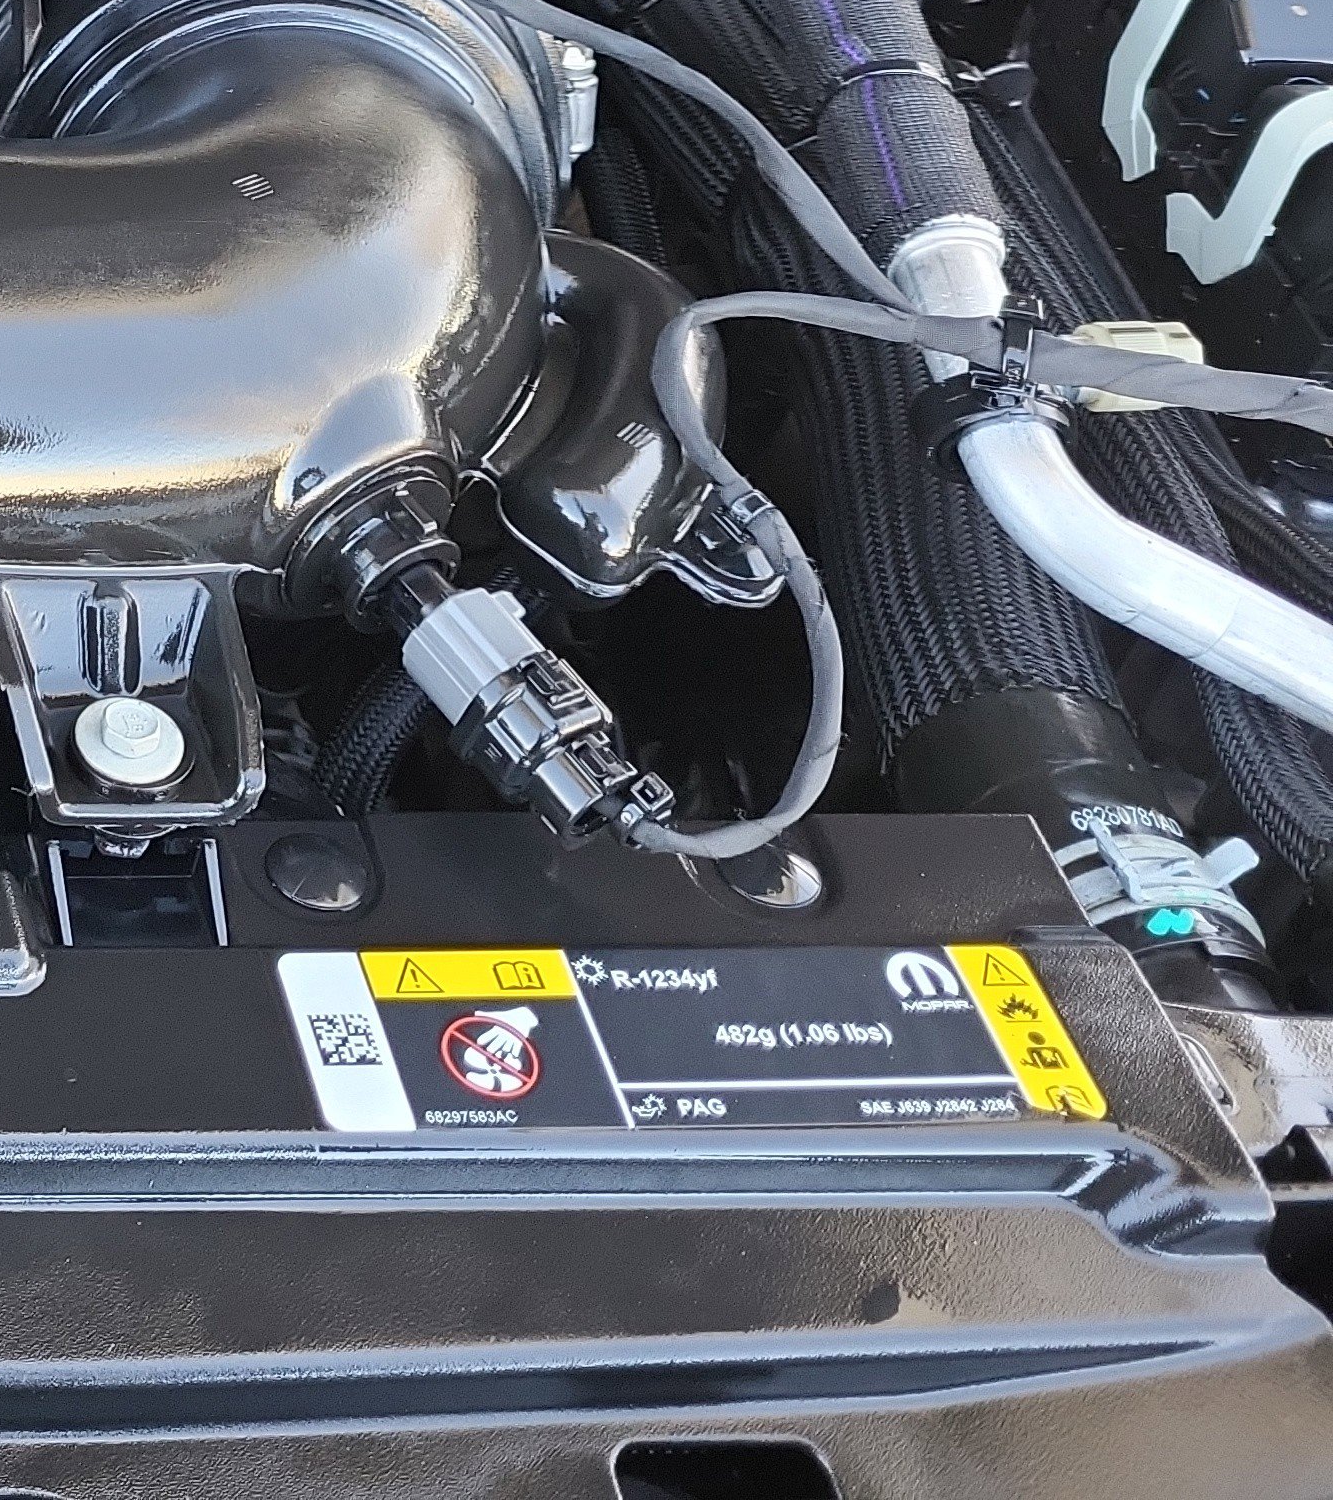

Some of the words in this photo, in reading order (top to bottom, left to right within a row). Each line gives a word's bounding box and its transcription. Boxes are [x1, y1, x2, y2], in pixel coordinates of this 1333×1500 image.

[610, 968, 719, 994] R-1234yf
[715, 1023, 777, 1049] 482g
[779, 1021, 840, 1049] (1.06
[842, 1021, 893, 1049] lbs)
[676, 1099, 728, 1118] PAG
[859, 1100, 895, 1115] SAE
[897, 1100, 932, 1114] J639
[934, 1098, 978, 1114] J2842
[980, 1097, 1019, 1113] J284
[424, 1109, 519, 1124] 68297583AC
